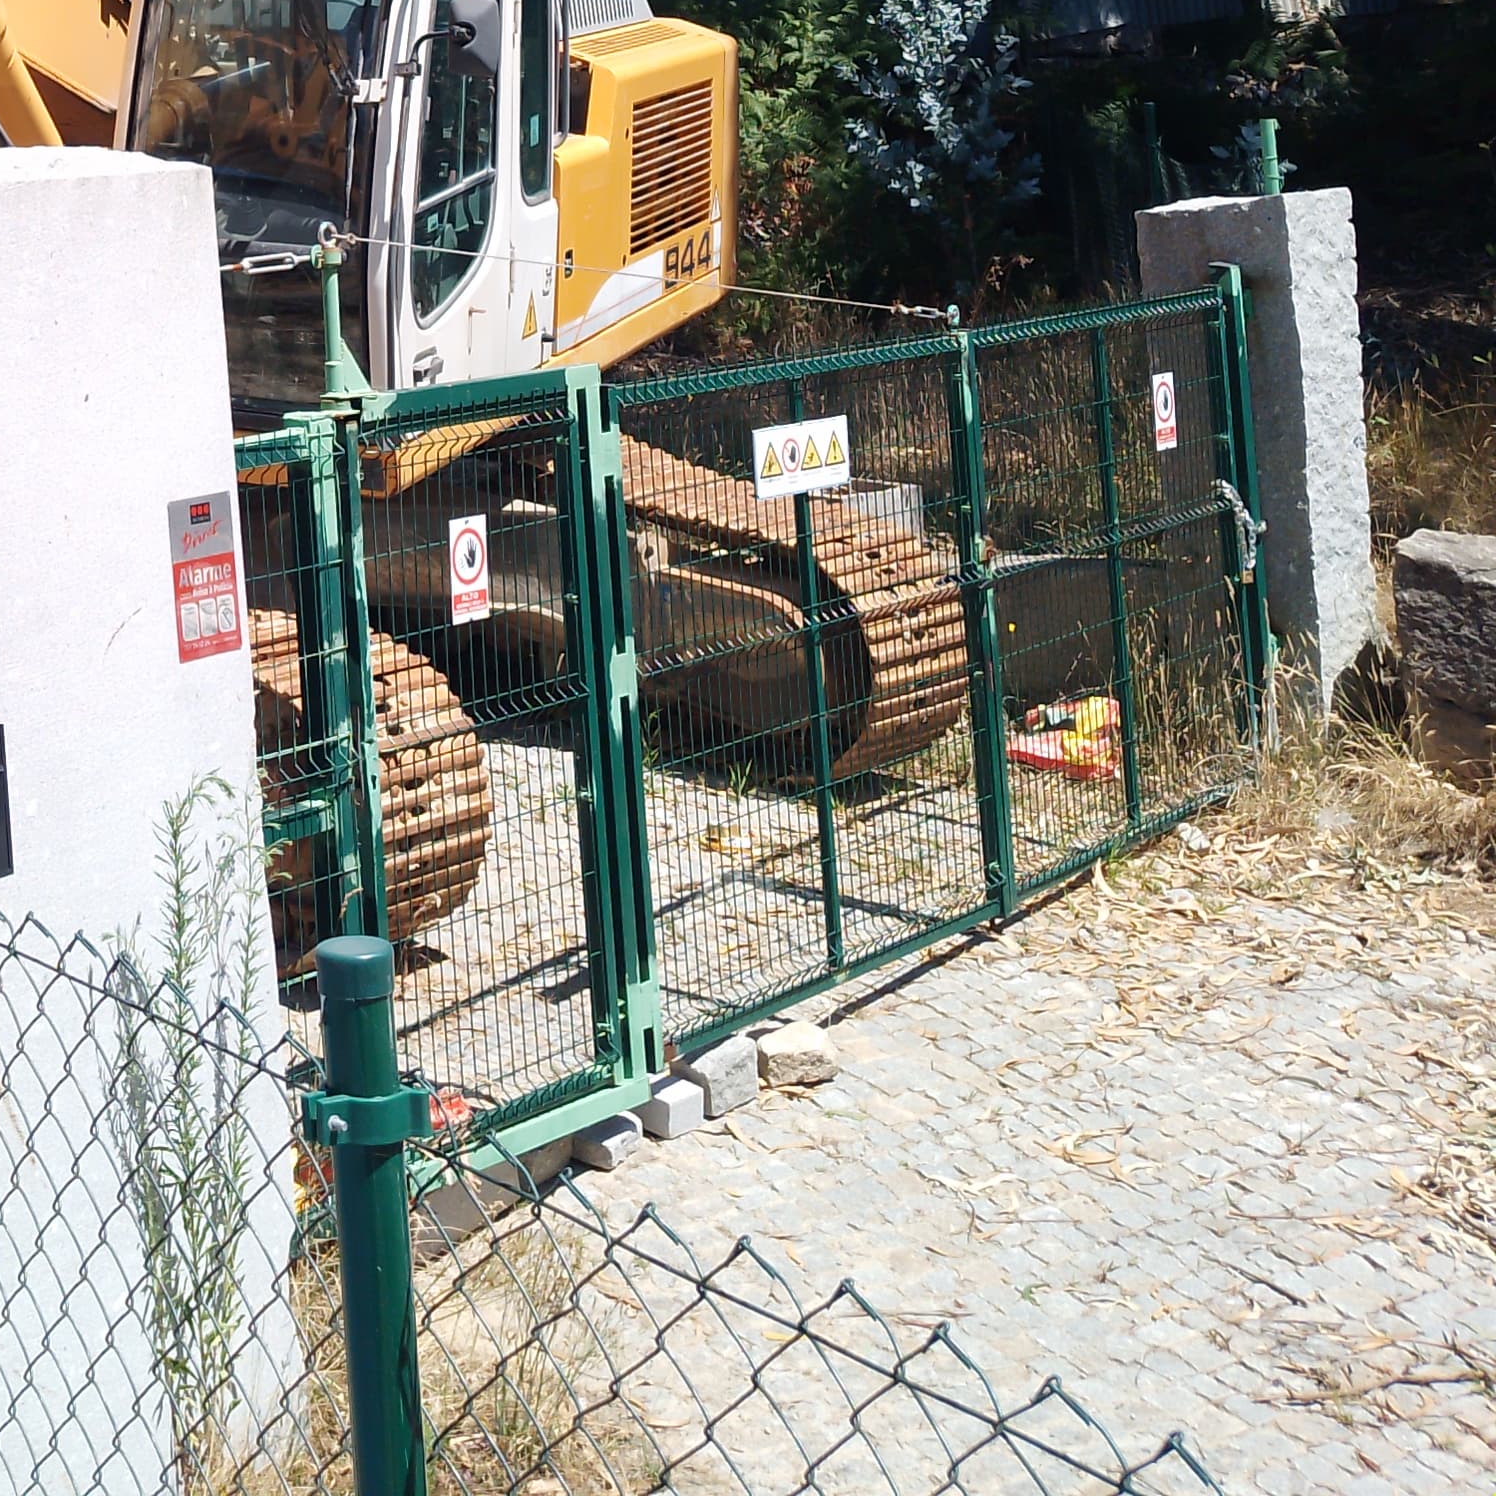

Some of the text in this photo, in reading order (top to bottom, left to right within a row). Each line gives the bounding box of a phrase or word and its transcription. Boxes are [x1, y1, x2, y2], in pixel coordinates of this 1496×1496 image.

[665, 230, 712, 289] 944
[179, 563, 231, 588] Alarme
[461, 591, 479, 601] ALTO
